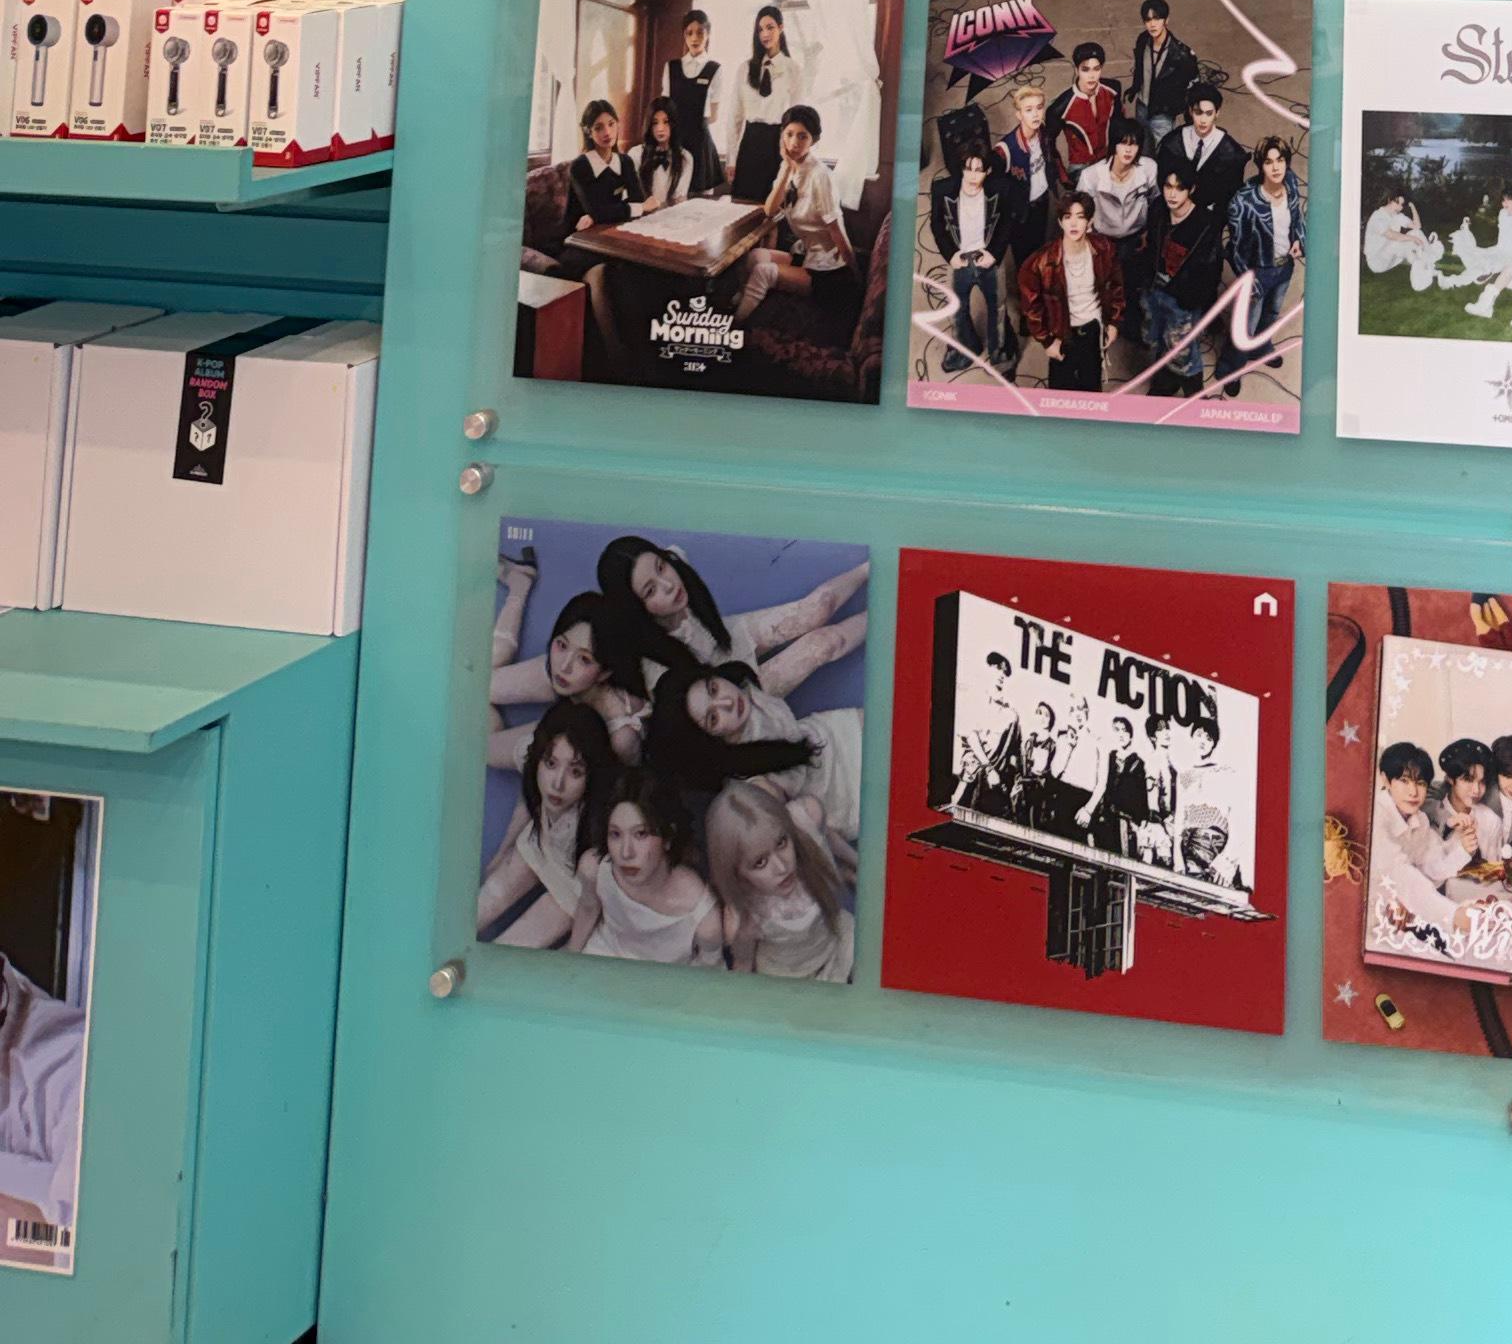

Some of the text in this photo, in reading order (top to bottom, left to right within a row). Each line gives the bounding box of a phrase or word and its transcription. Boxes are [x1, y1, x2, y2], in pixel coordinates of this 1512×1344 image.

[663, 299, 735, 335] Sunday
[650, 318, 745, 350] Morning
[189, 377, 228, 391] RANDOM
[194, 367, 225, 379] ALBUM
[198, 388, 217, 400] BOX
[1014, 615, 1219, 729] THE ACTION
